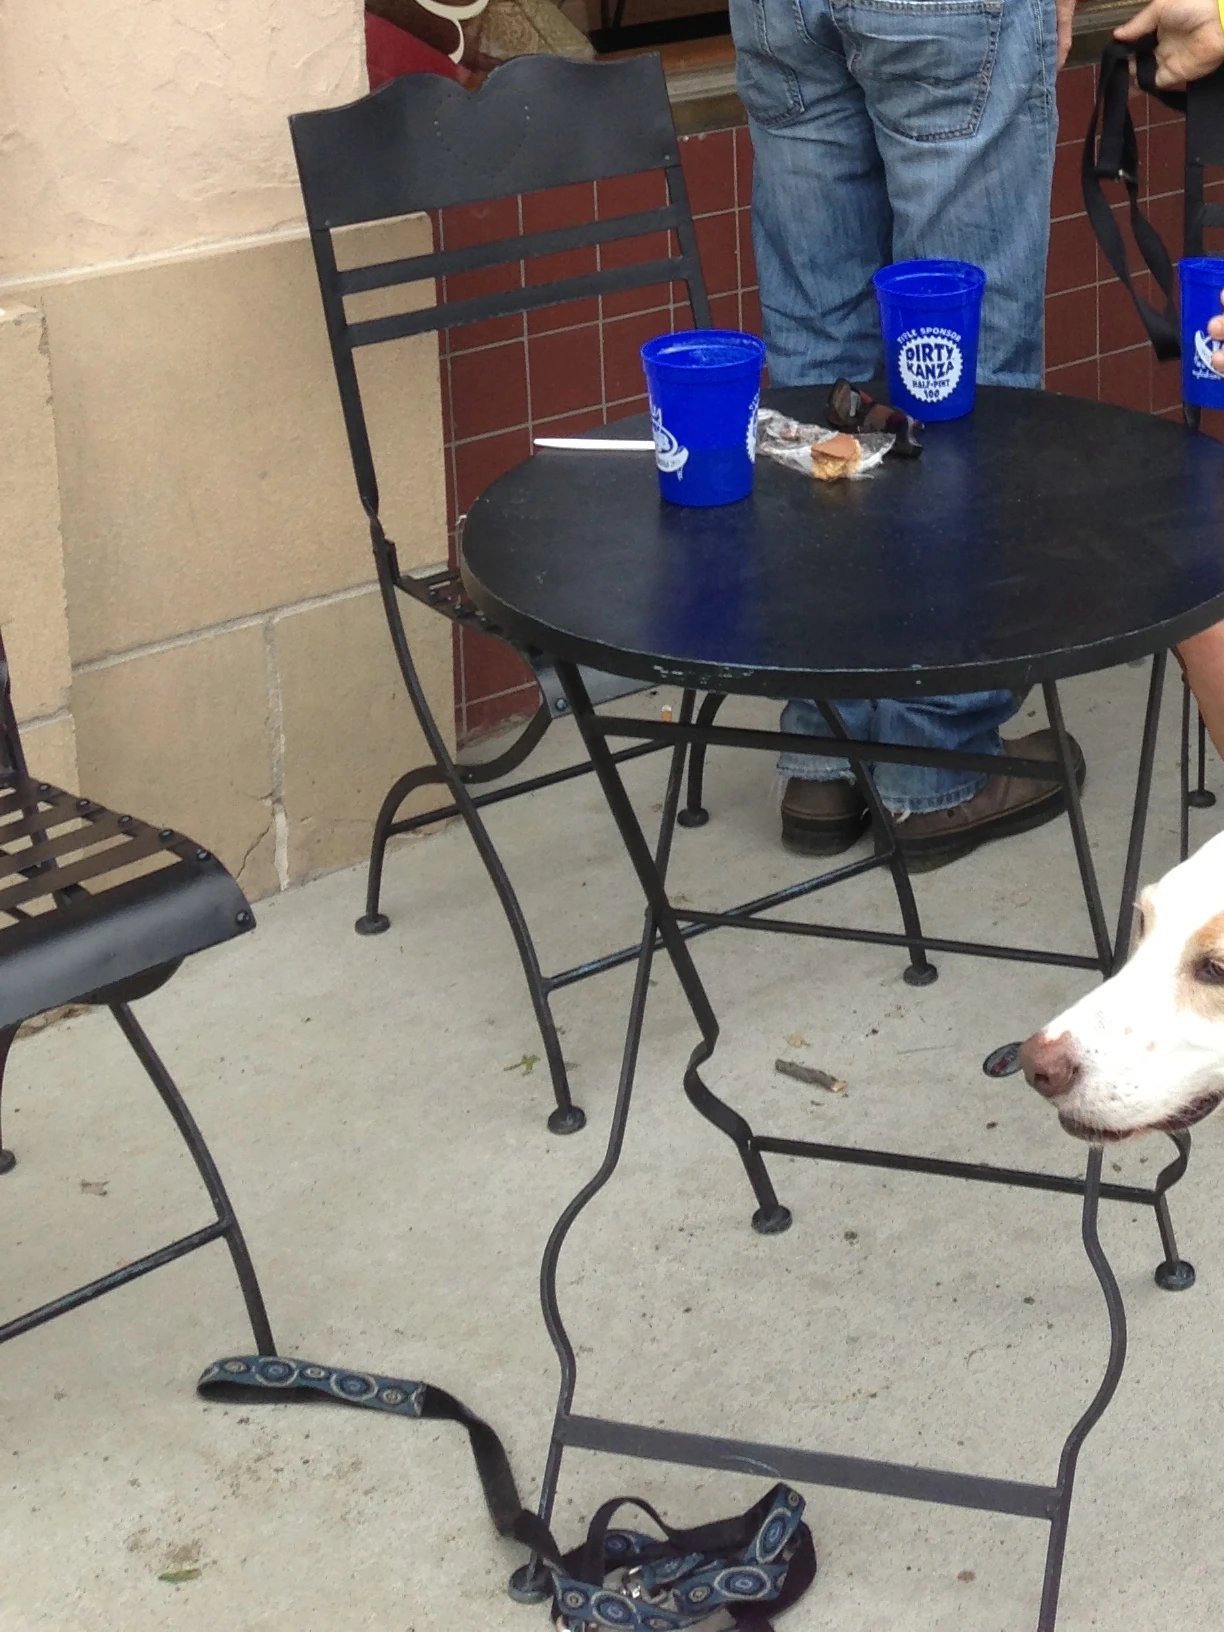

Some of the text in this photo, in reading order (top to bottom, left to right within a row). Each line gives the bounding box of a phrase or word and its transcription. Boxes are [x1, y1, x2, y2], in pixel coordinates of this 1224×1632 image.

[920, 327, 962, 343] SPONSOR
[905, 342, 954, 362] DIRTY
[906, 360, 954, 380] KANZA
[923, 389, 940, 399] 100
